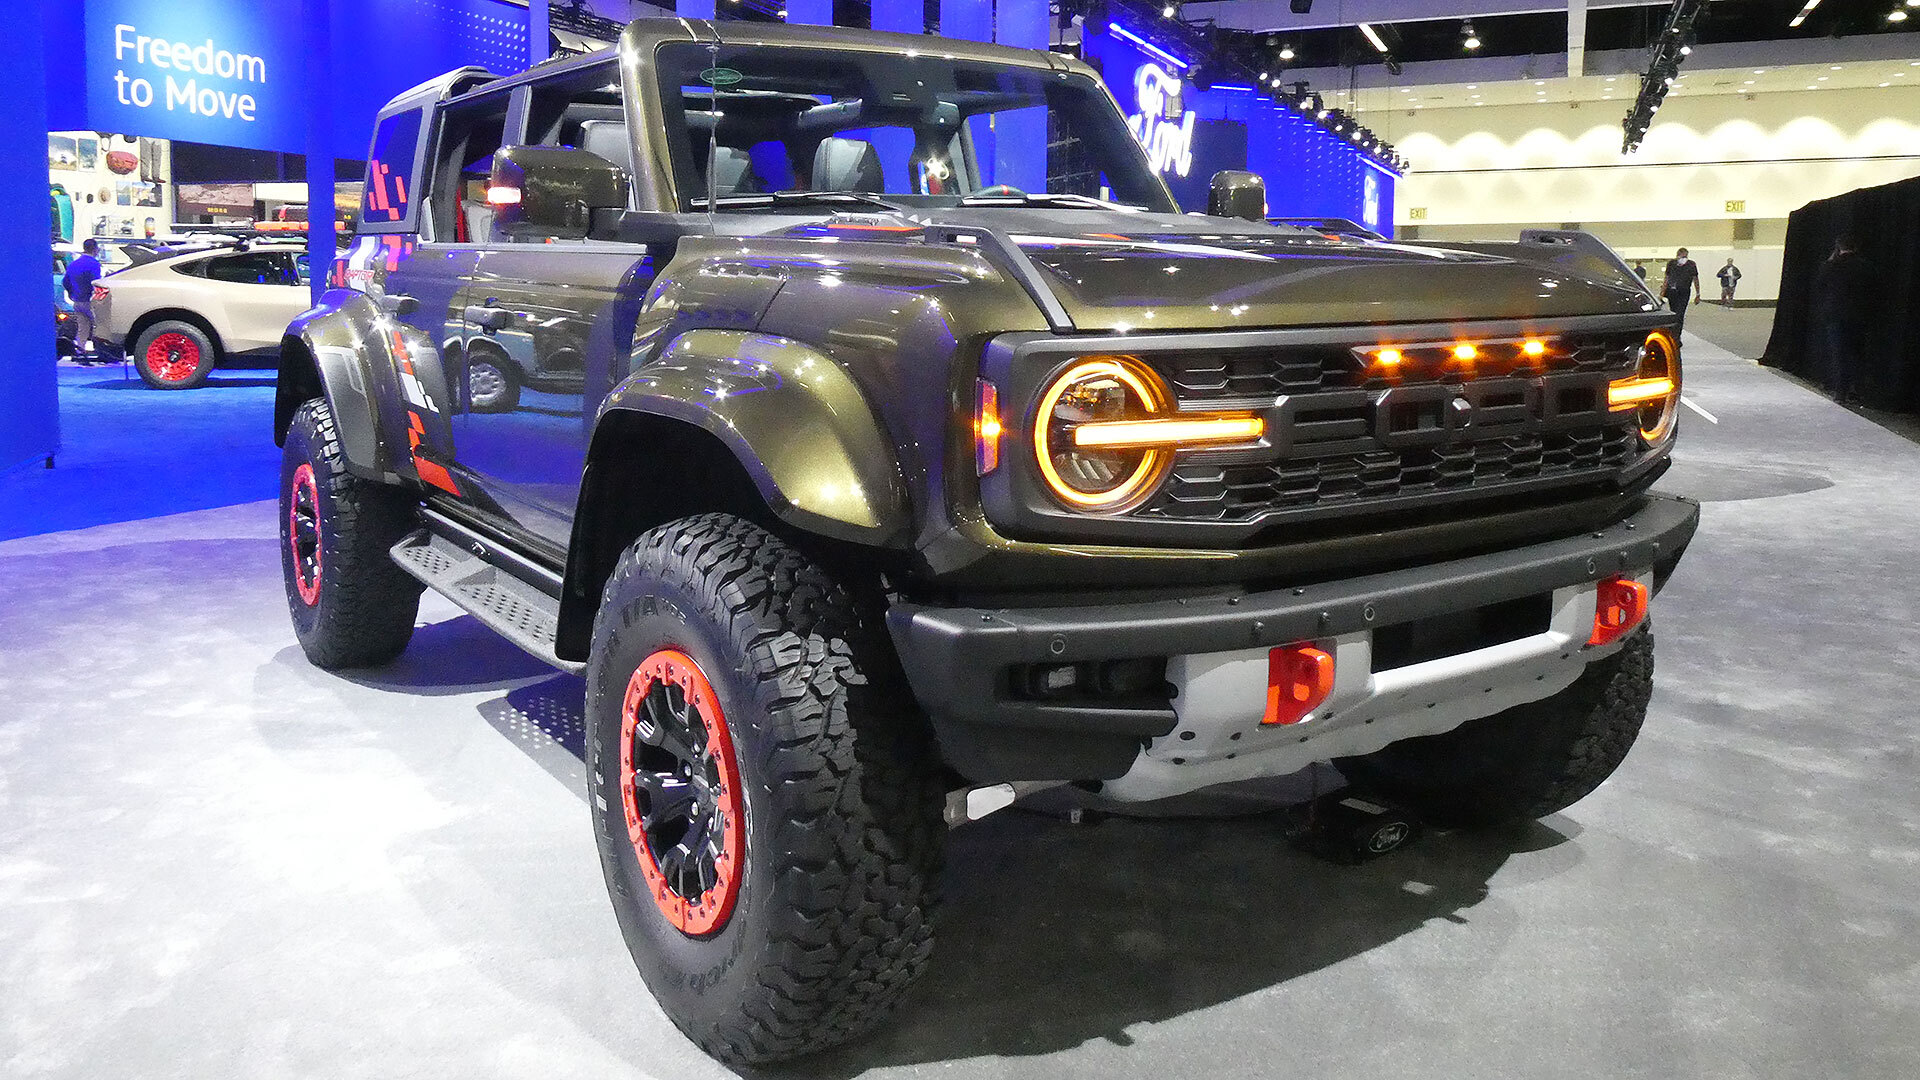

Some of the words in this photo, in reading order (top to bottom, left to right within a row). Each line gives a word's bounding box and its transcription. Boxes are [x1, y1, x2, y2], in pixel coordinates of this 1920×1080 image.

[115, 23, 266, 84] Freedom
[114, 69, 153, 108] to
[166, 75, 256, 122] Move
[1127, 63, 1196, 178] Ford
[1410, 208, 1427, 219] EXIT
[1726, 201, 1745, 212] EXIT
